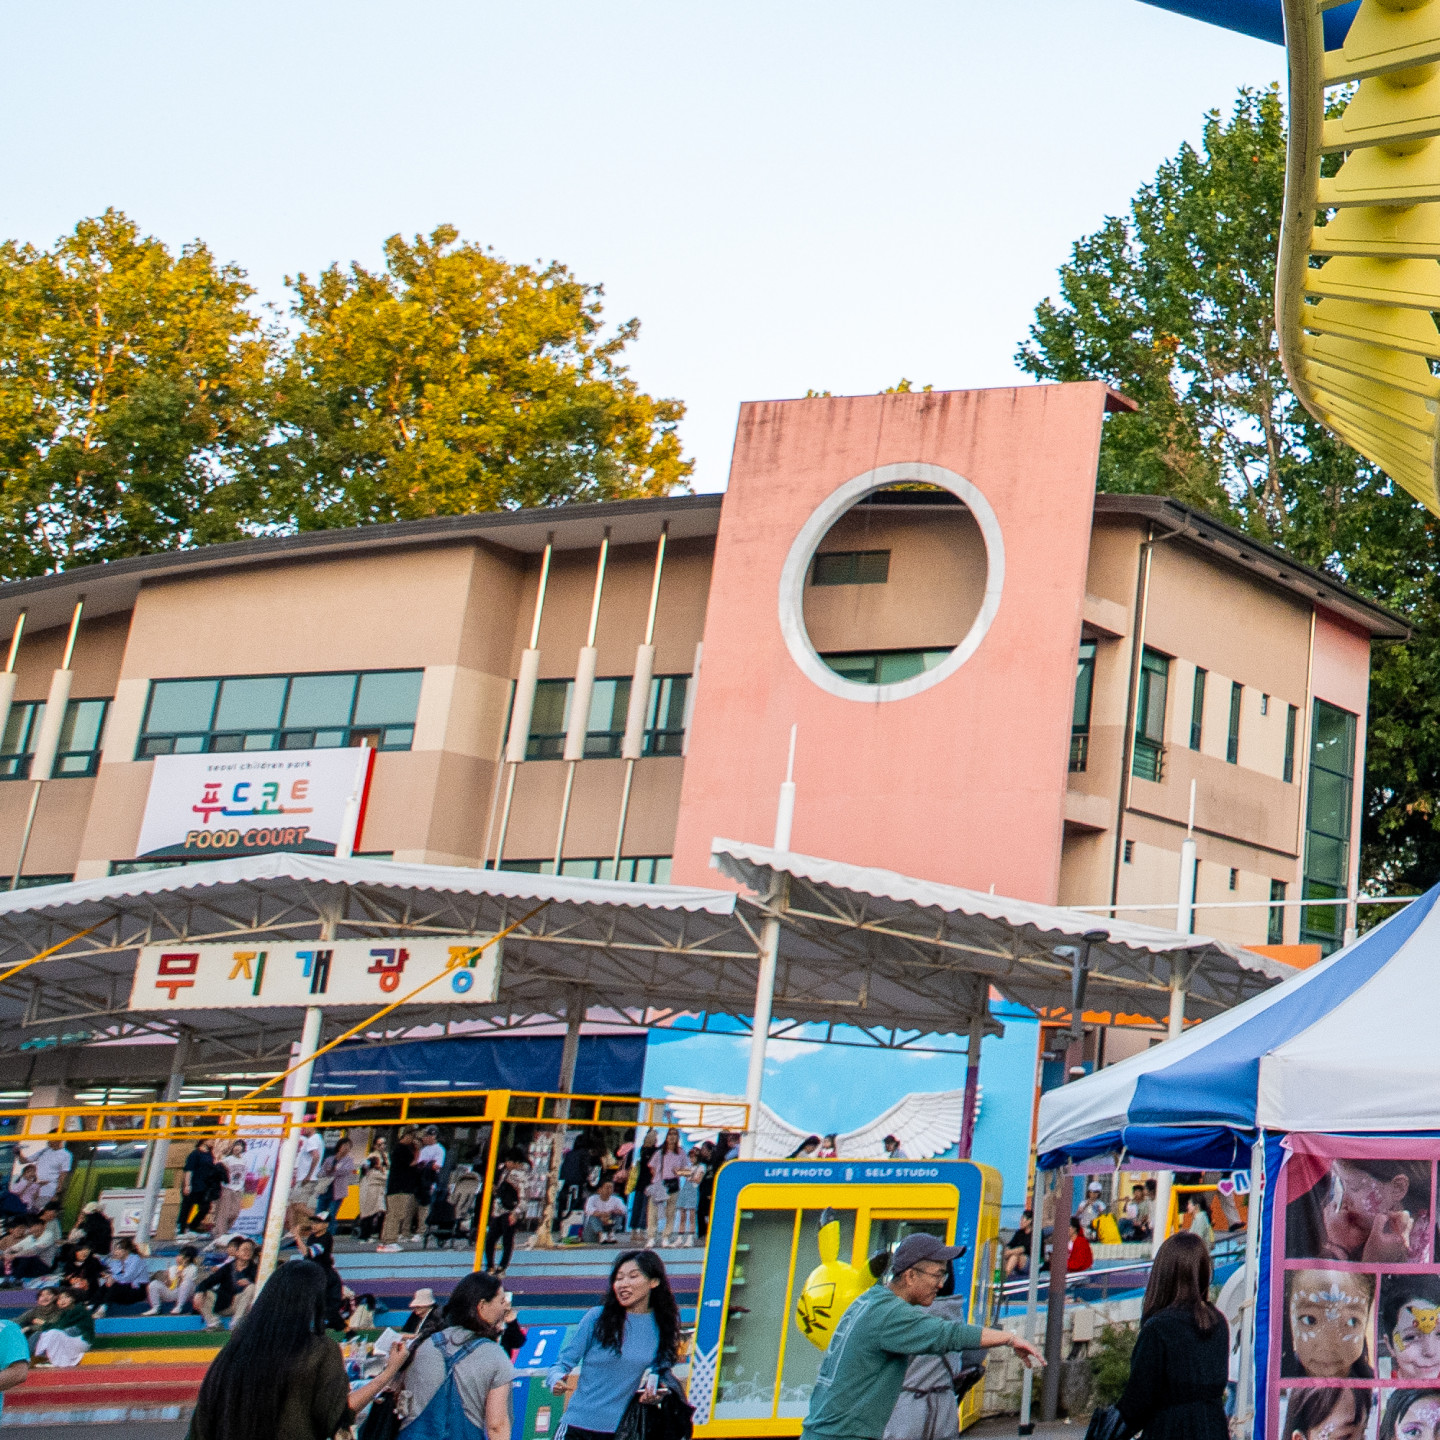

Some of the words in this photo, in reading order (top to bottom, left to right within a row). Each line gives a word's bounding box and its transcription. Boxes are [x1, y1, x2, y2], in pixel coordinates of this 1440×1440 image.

[192, 779, 313, 823] 푸드코트
[184, 829, 240, 848] FOOD
[243, 826, 309, 847] COURT
[764, 1168, 789, 1177] LIFE
[792, 1168, 833, 1177] PHOTO
[865, 1168, 894, 1177] SELF
[895, 1168, 939, 1177] STUDIO
